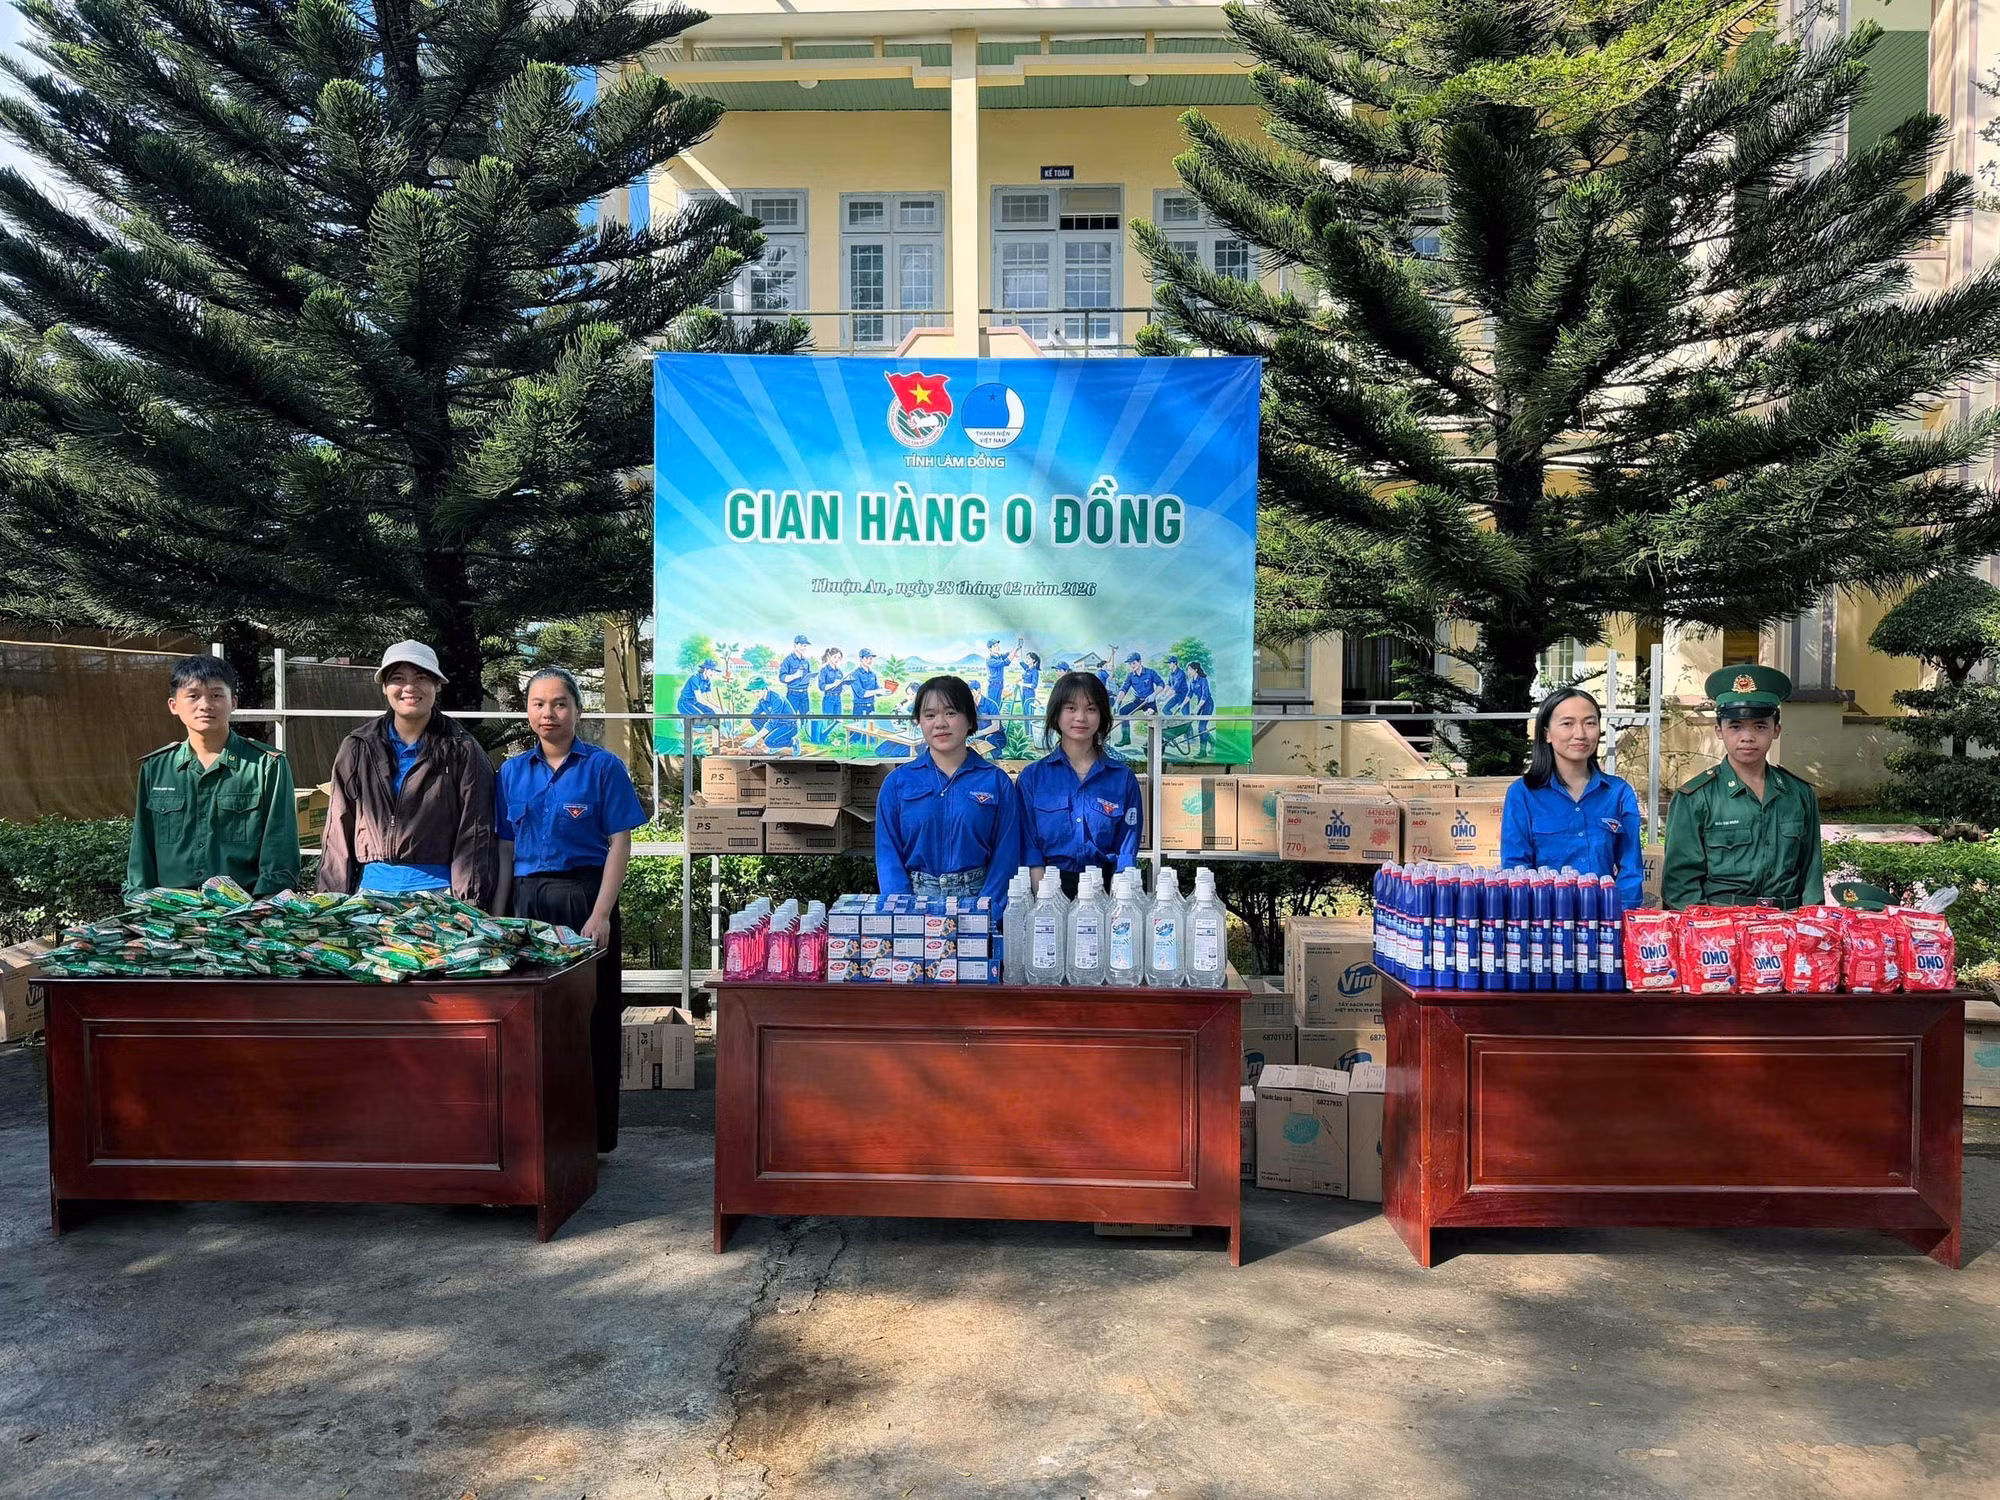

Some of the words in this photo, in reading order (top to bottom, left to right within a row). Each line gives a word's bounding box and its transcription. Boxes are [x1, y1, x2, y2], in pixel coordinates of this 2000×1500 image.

[938, 454, 964, 468] LÂM
[967, 452, 1006, 468] ĐỒNG
[728, 492, 840, 541] GIAN
[857, 484, 987, 544] HÀNG
[1052, 478, 1182, 545] ĐỒNG
[812, 578, 862, 596] Thuận
[896, 582, 932, 599] ngày
[934, 580, 954, 596] 28
[956, 578, 1002, 600] tháng
[1004, 580, 1022, 597] 02
[1023, 580, 1060, 597] năm
[1061, 581, 1097, 597] 2026
[1325, 824, 1350, 838] OMO
[1451, 824, 1476, 837] OMO
[1156, 923, 1174, 934] Sunlight
[1640, 944, 1667, 959] OMO
[1702, 950, 1728, 965] OMO
[1754, 956, 1780, 970] OMO
[1917, 955, 1944, 969] OMO
[1341, 972, 1377, 992] Vim
